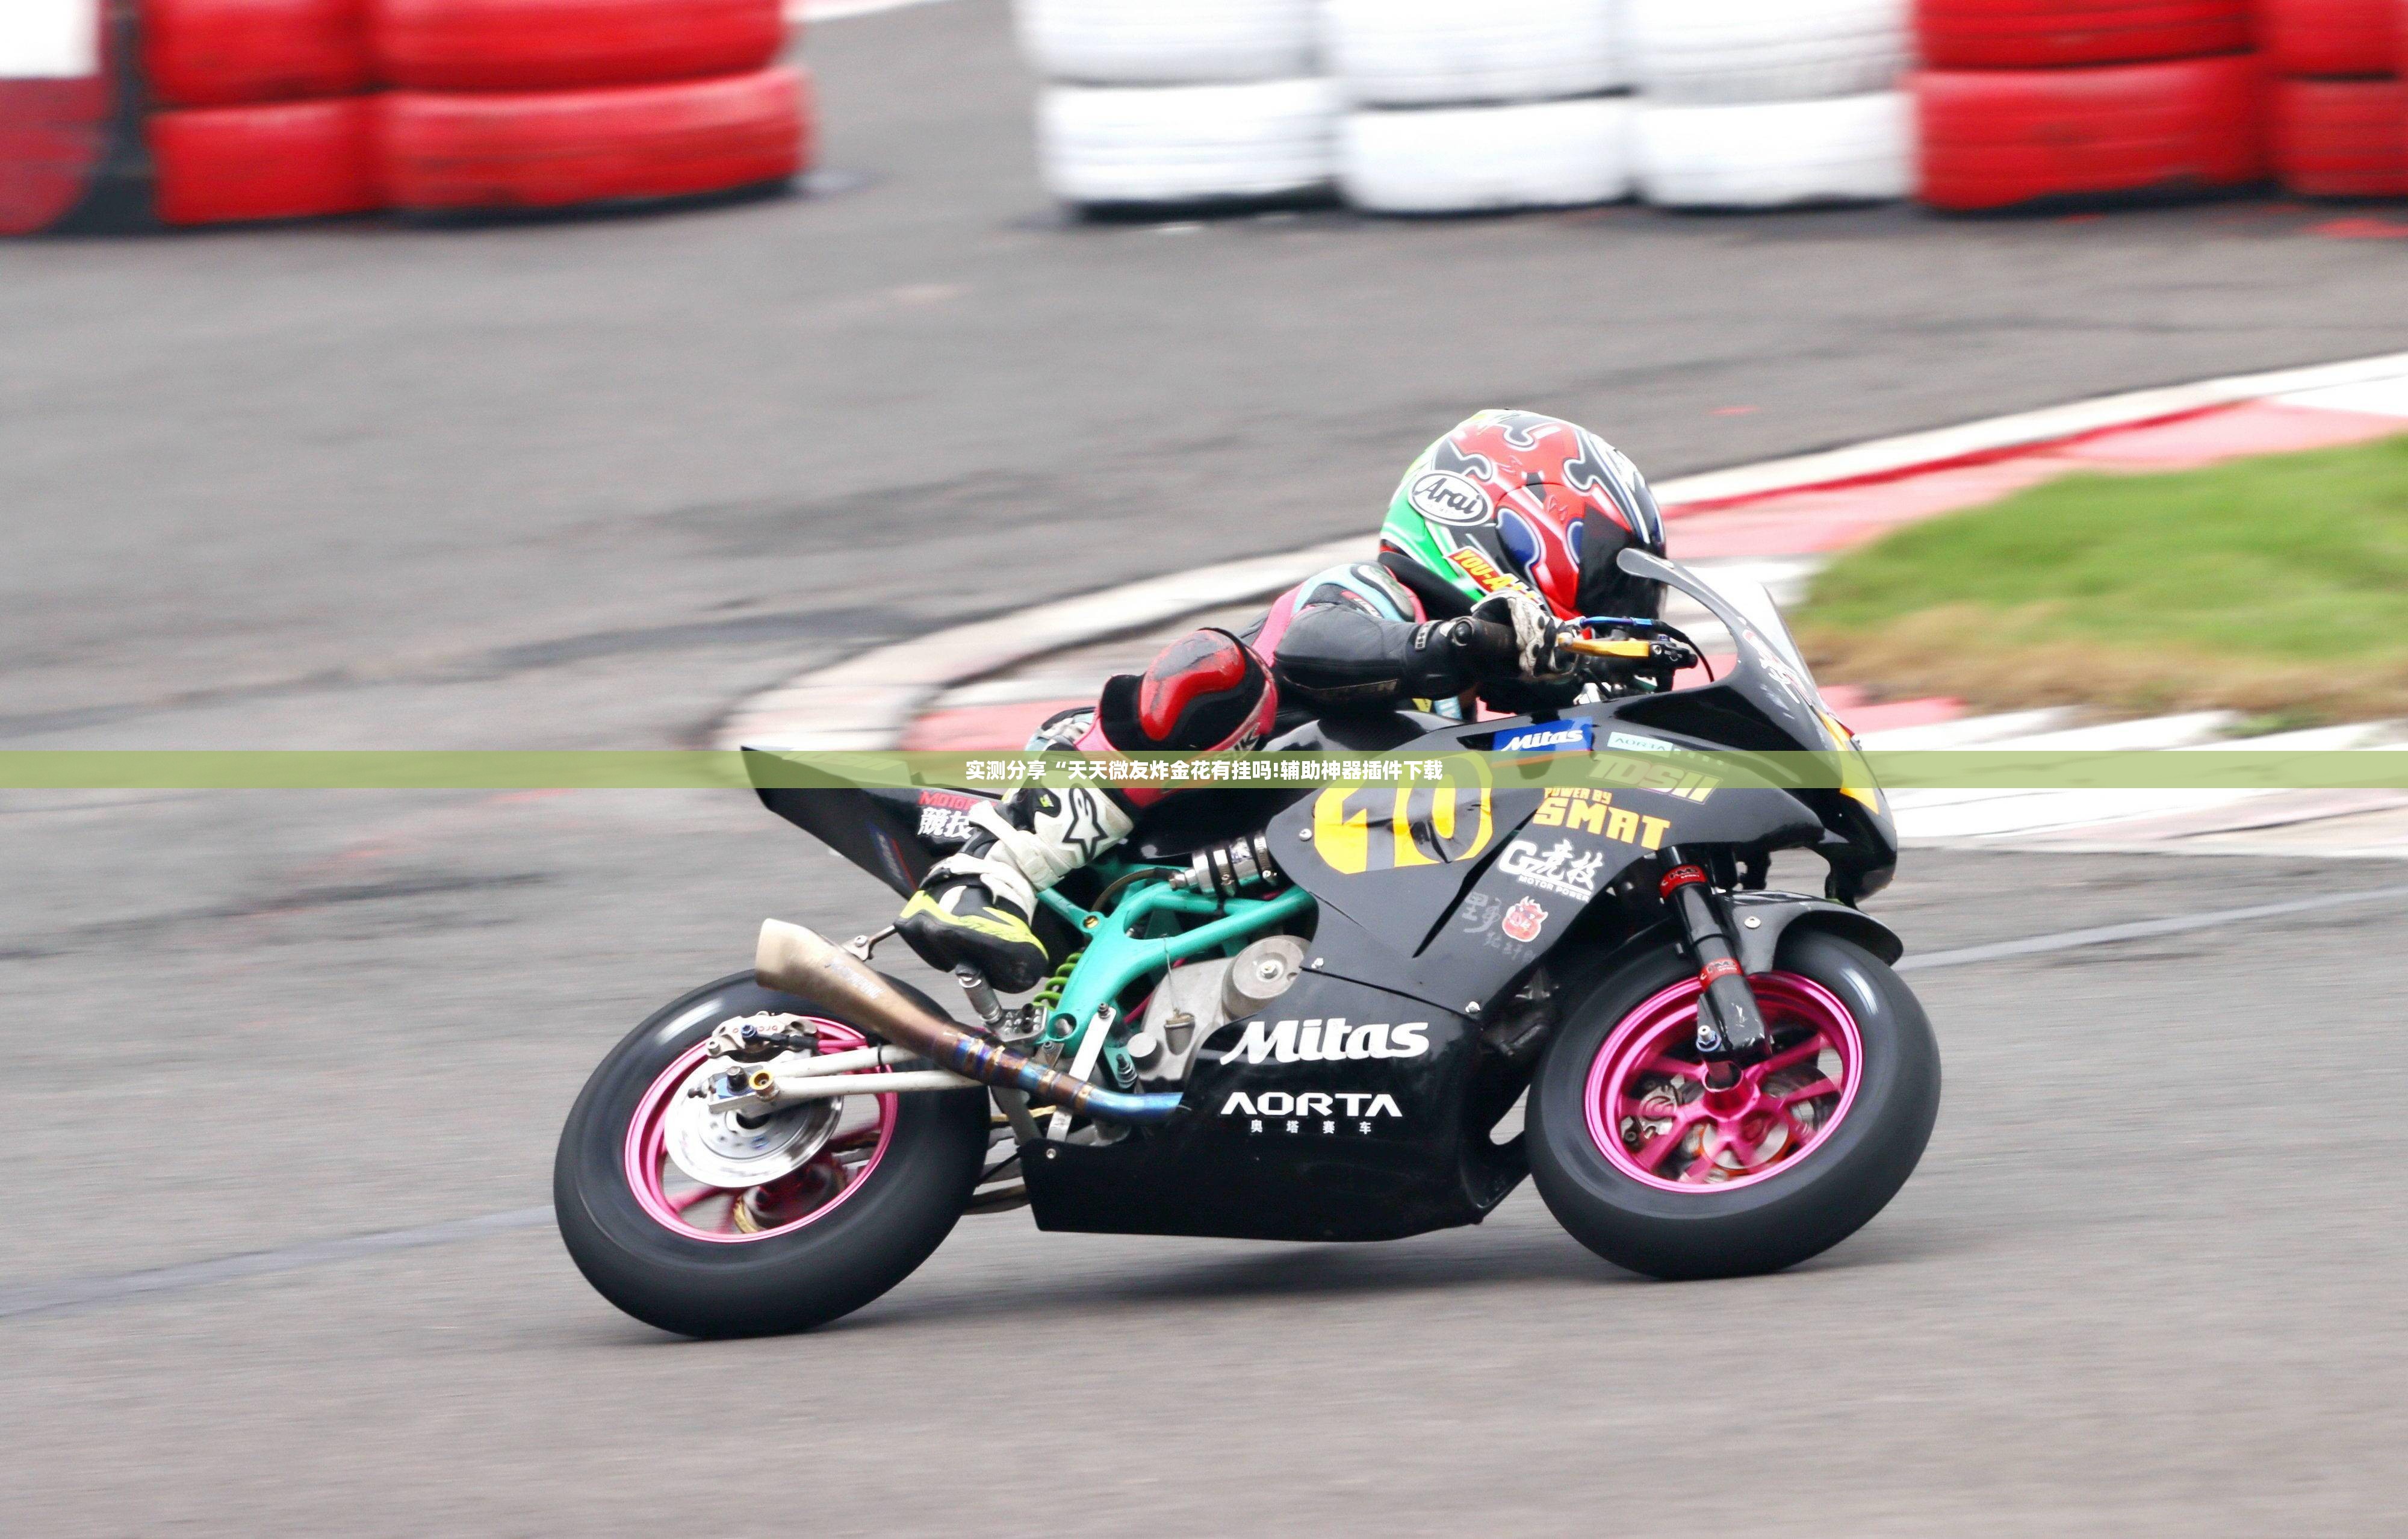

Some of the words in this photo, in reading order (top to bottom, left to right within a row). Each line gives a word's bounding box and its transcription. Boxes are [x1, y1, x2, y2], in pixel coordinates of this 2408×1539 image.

[1413, 477, 1482, 514] Arai
[1454, 549, 1537, 598] YOU-A
[1500, 730, 1583, 753] Mitas
[1544, 786, 1590, 800] POWER
[1593, 789, 1613, 805] BY
[1532, 797, 1671, 851] SMAT
[1518, 874, 1553, 891] MOTOR
[1555, 885, 1590, 902] POWER
[1220, 1018, 1429, 1065] Mitas
[1220, 1092, 1403, 1117] AORTA
[1251, 1119, 1371, 1134] 奥塔赛车
